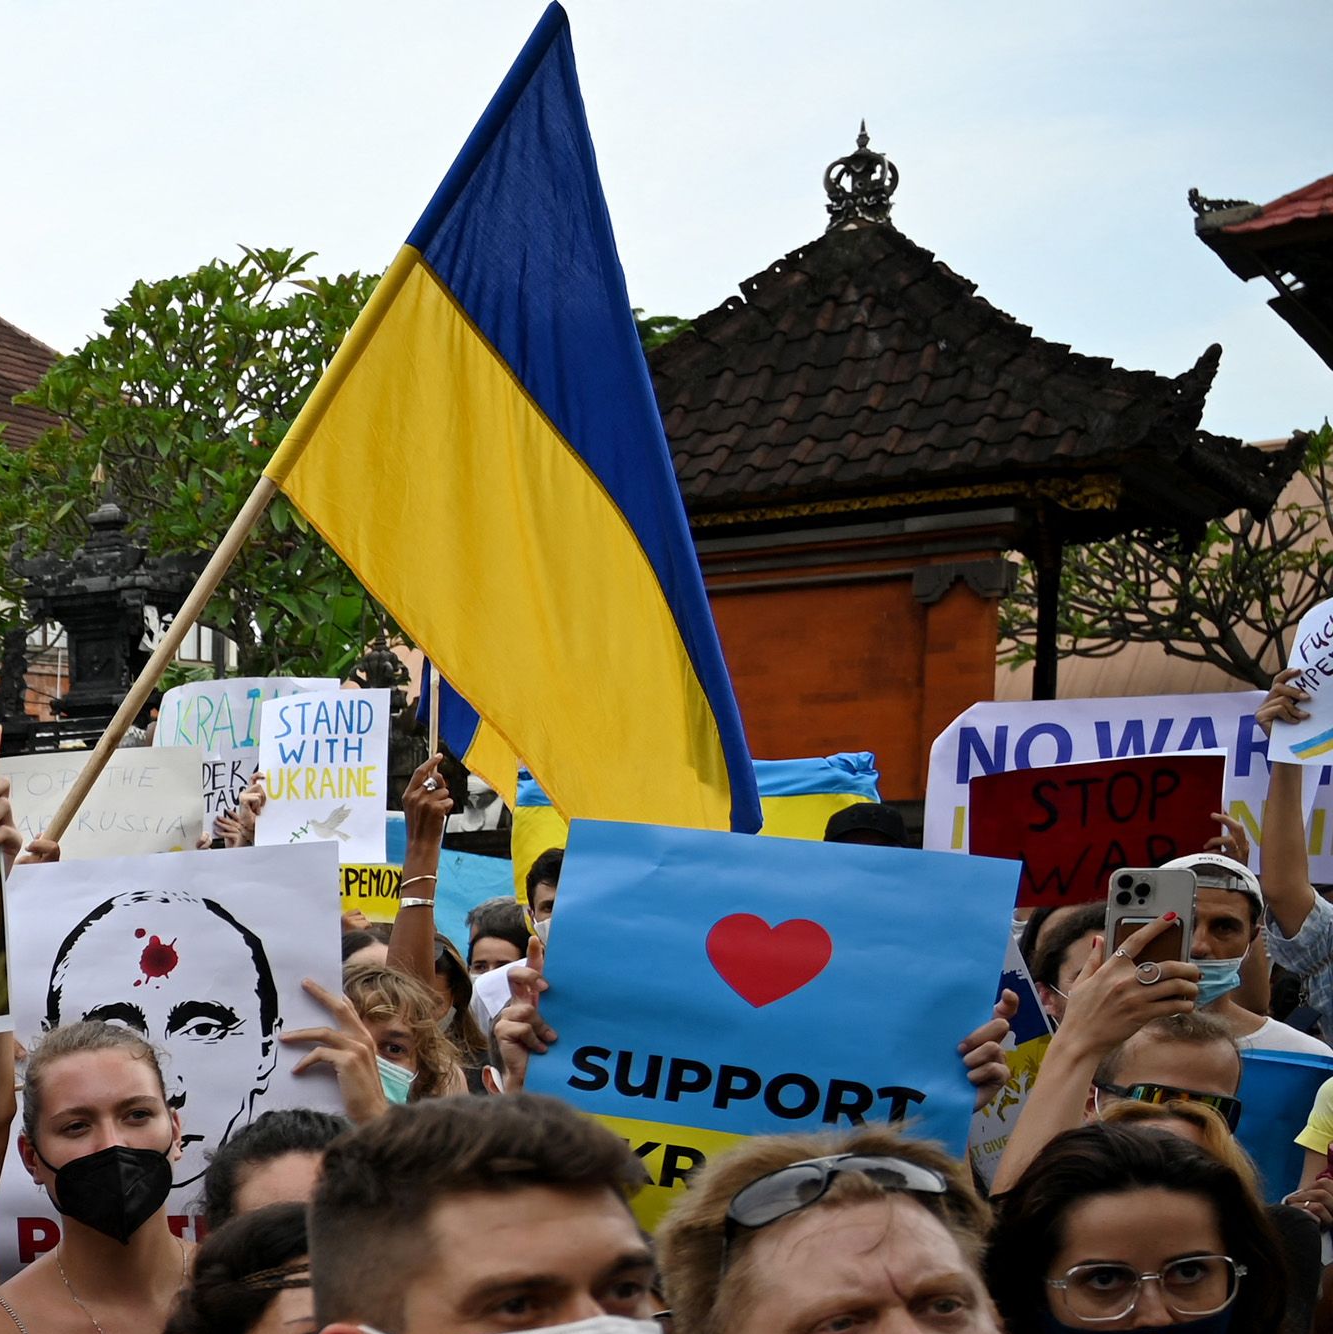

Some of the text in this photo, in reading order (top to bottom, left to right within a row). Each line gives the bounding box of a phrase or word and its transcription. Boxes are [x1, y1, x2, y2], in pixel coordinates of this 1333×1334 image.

[274, 699, 374, 739] STAND
[278, 737, 364, 765] WITH
[106, 766, 161, 789] THE
[266, 765, 378, 801] UKRAINE
[1029, 768, 1181, 832] STOP
[77, 809, 187, 839] RUSSIA
[566, 1044, 927, 1132] SUPPORT
